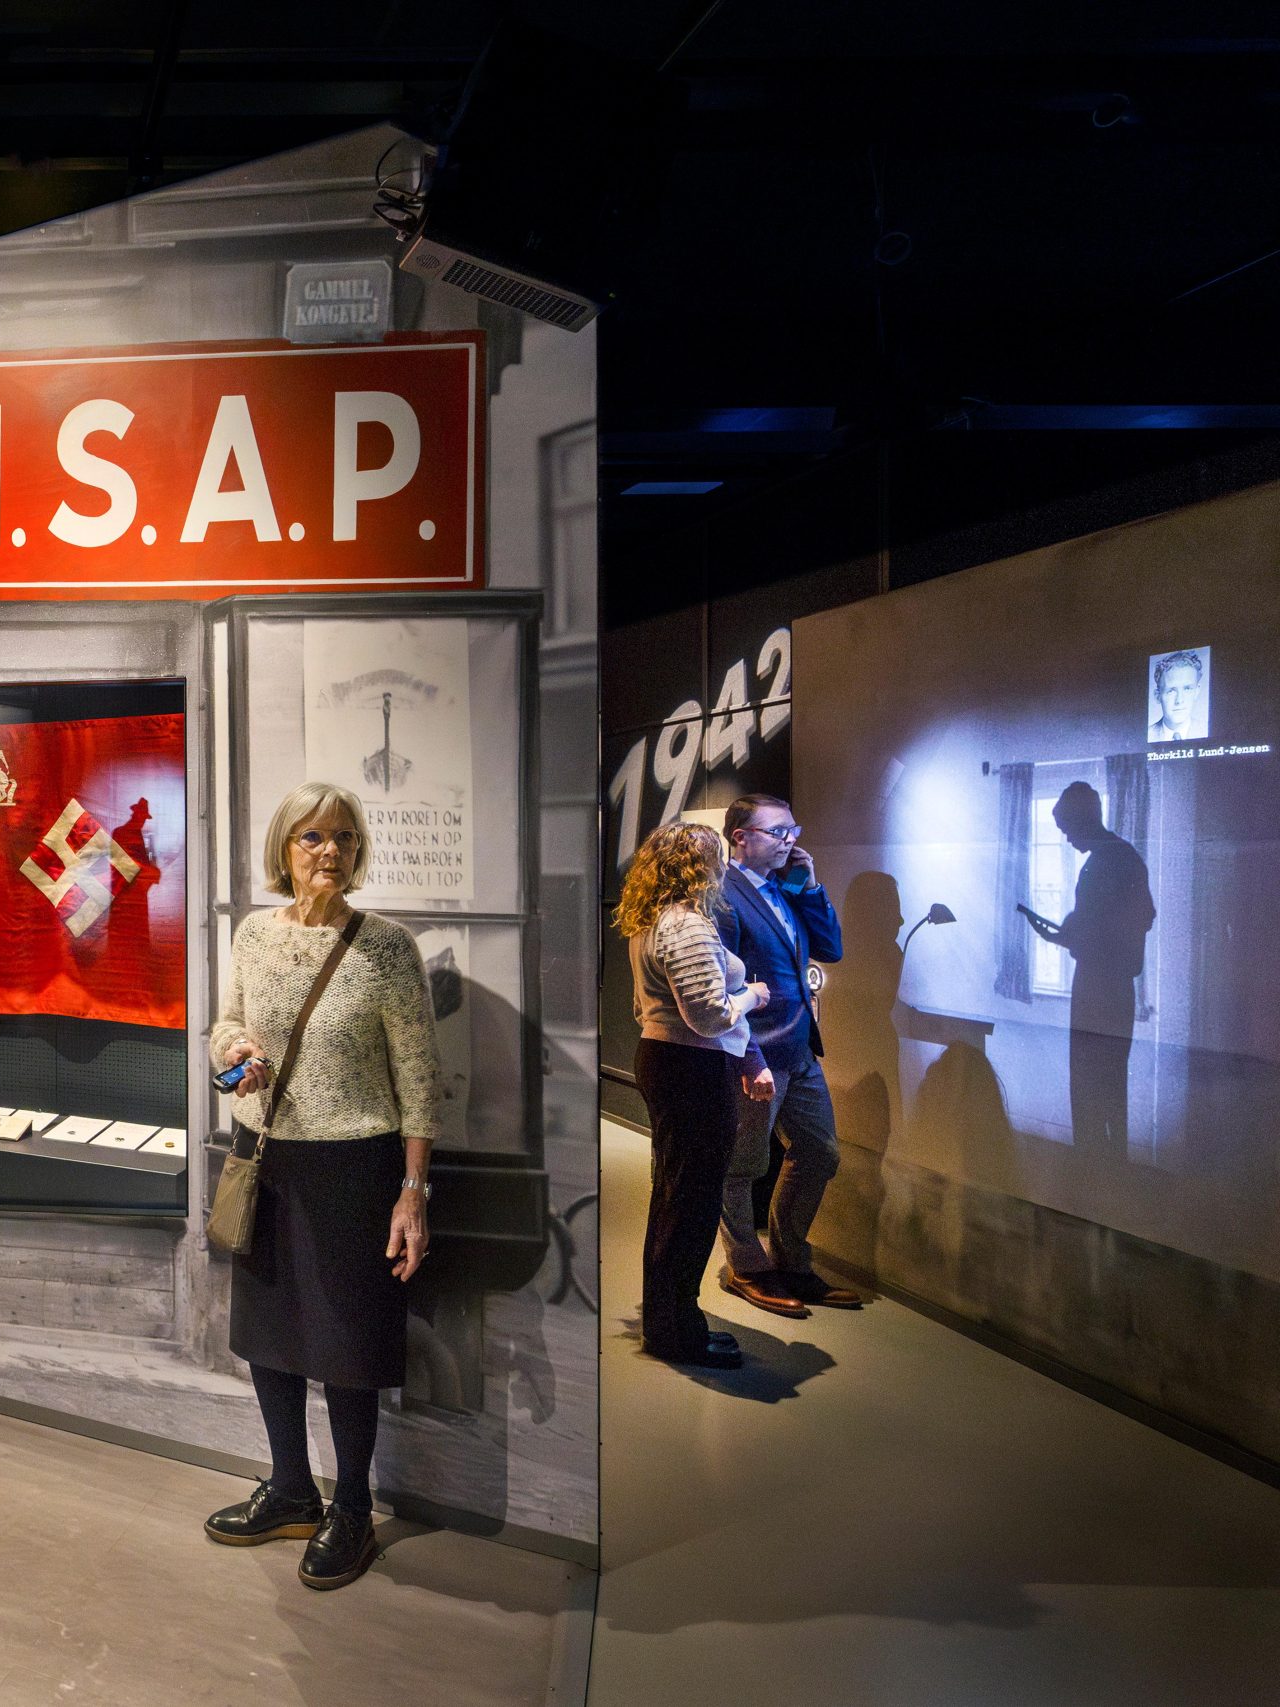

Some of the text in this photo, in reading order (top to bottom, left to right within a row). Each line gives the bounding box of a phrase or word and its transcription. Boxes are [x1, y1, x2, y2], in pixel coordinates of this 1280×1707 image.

[608, 627, 791, 870] 1942
[1147, 744, 1271, 760] Thorkild Lund-Jensen
[442, 810, 463, 827] OM
[436, 871, 463, 888] TOP
